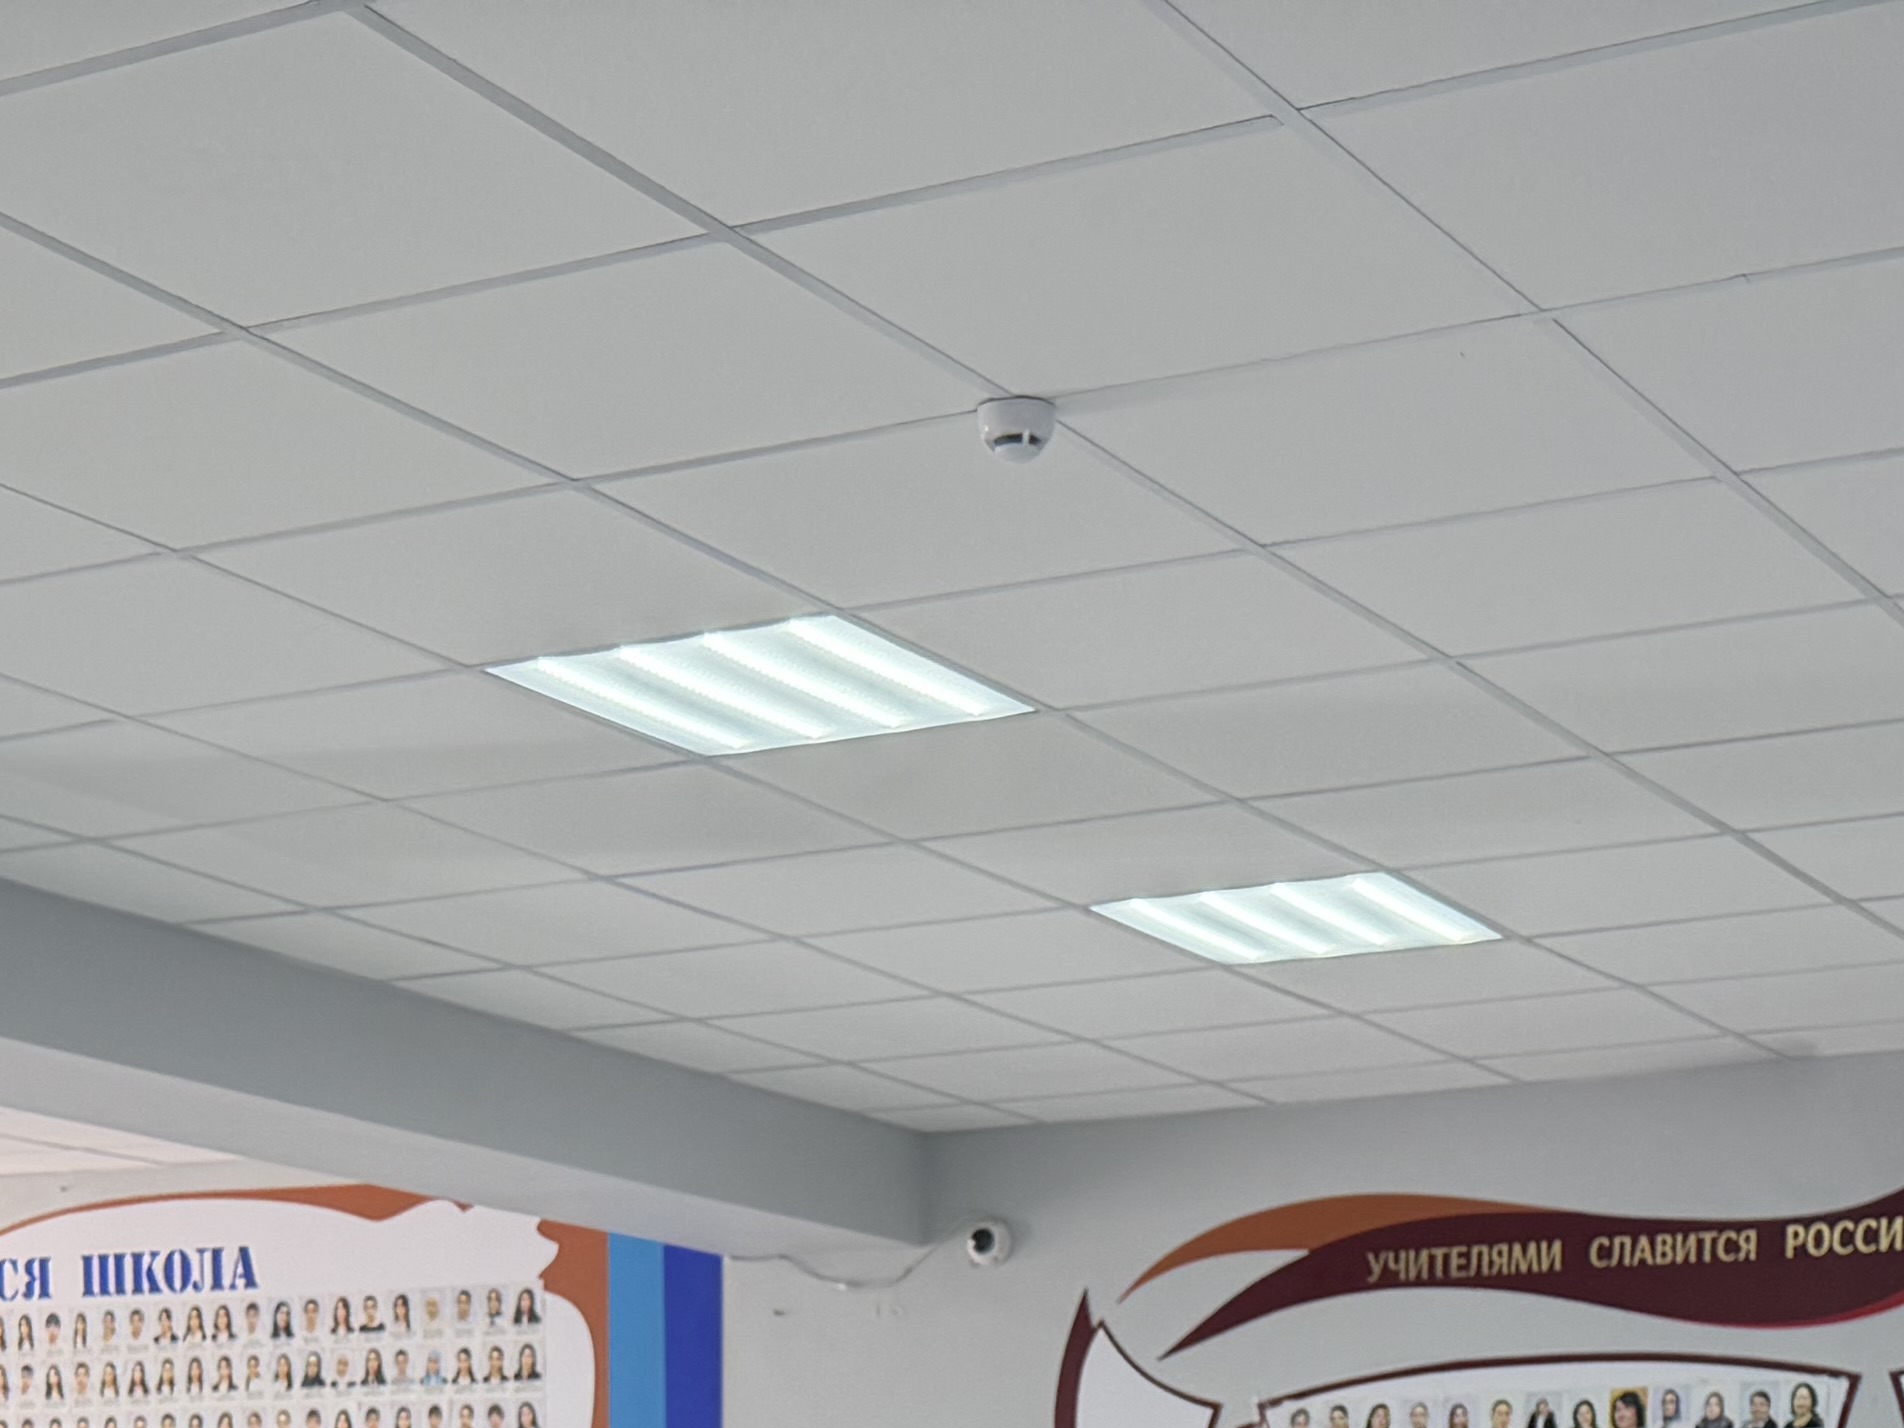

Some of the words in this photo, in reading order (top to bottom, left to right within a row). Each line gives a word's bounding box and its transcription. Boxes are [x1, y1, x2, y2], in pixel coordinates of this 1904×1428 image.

[81, 1245, 259, 1300] ШКОЛА
[1367, 1239, 1563, 1284] УЧИТЕЛЯМИ
[1589, 1228, 1758, 1269] СЛАВИТСЯ
